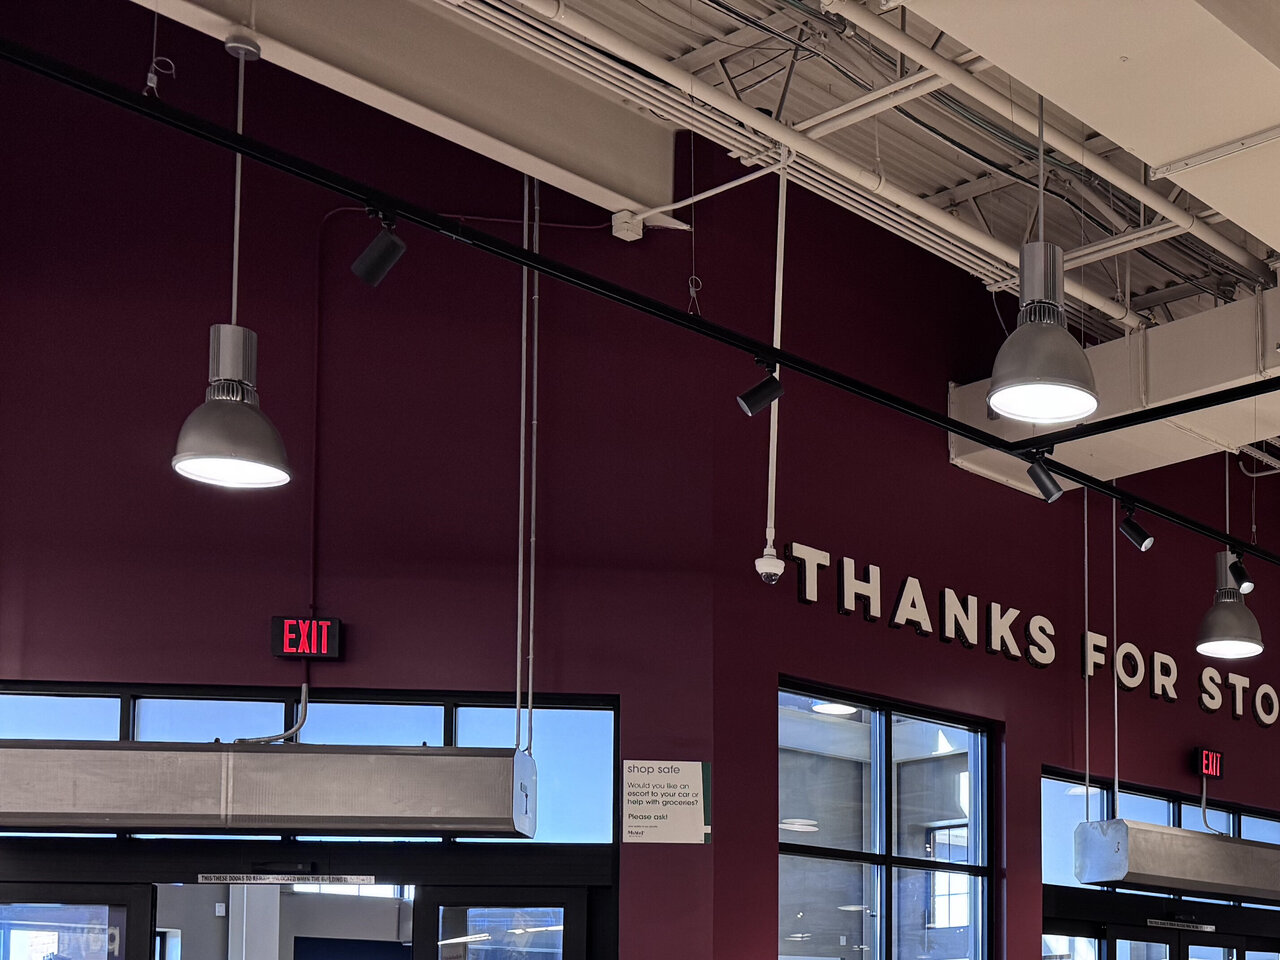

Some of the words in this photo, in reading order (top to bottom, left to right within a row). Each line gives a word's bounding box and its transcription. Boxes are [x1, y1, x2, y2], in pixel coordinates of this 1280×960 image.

[789, 541, 1056, 667] THANKS
[1085, 630, 1178, 700] FOR
[283, 619, 332, 654] EXIT
[627, 765, 654, 775] shop
[657, 765, 681, 774] safe
[1202, 750, 1222, 777] EXIT
[661, 799, 699, 807] groceries?
